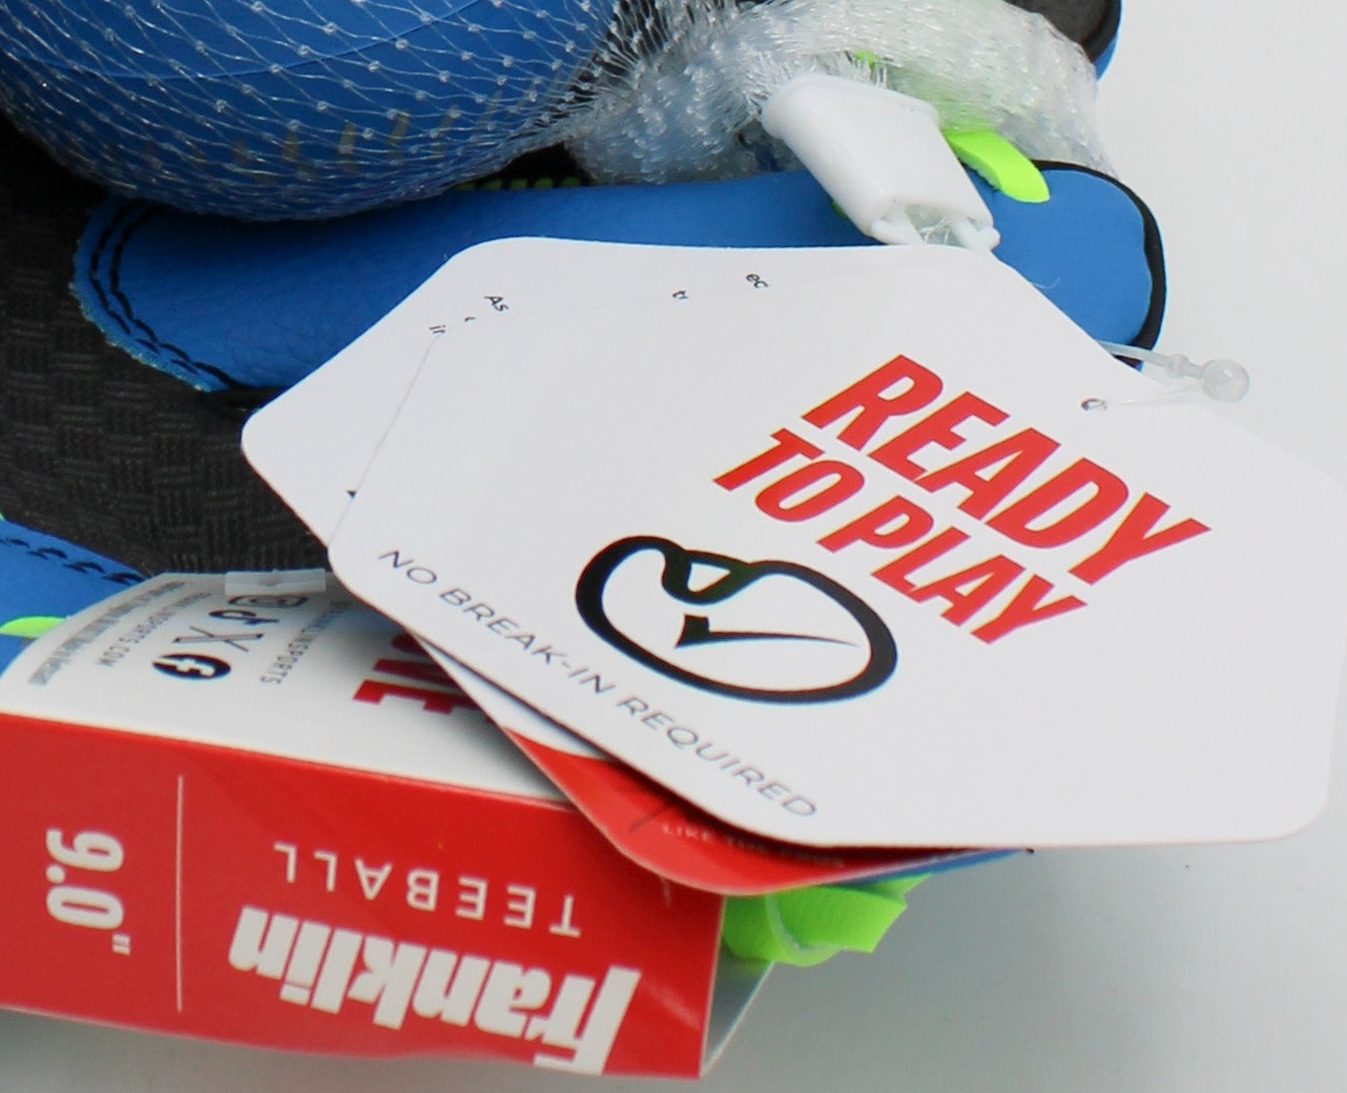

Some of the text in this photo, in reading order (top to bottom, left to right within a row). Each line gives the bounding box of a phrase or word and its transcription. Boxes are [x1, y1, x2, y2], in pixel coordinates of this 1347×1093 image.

[711, 427, 1088, 645] TO PLAY
[801, 354, 1212, 586] READY
[378, 549, 817, 817] NO BREAK-IN REQUIRED
[273, 840, 581, 938] TEEBALL
[660, 820, 715, 845] LIKE
[227, 905, 643, 1076] franklin
